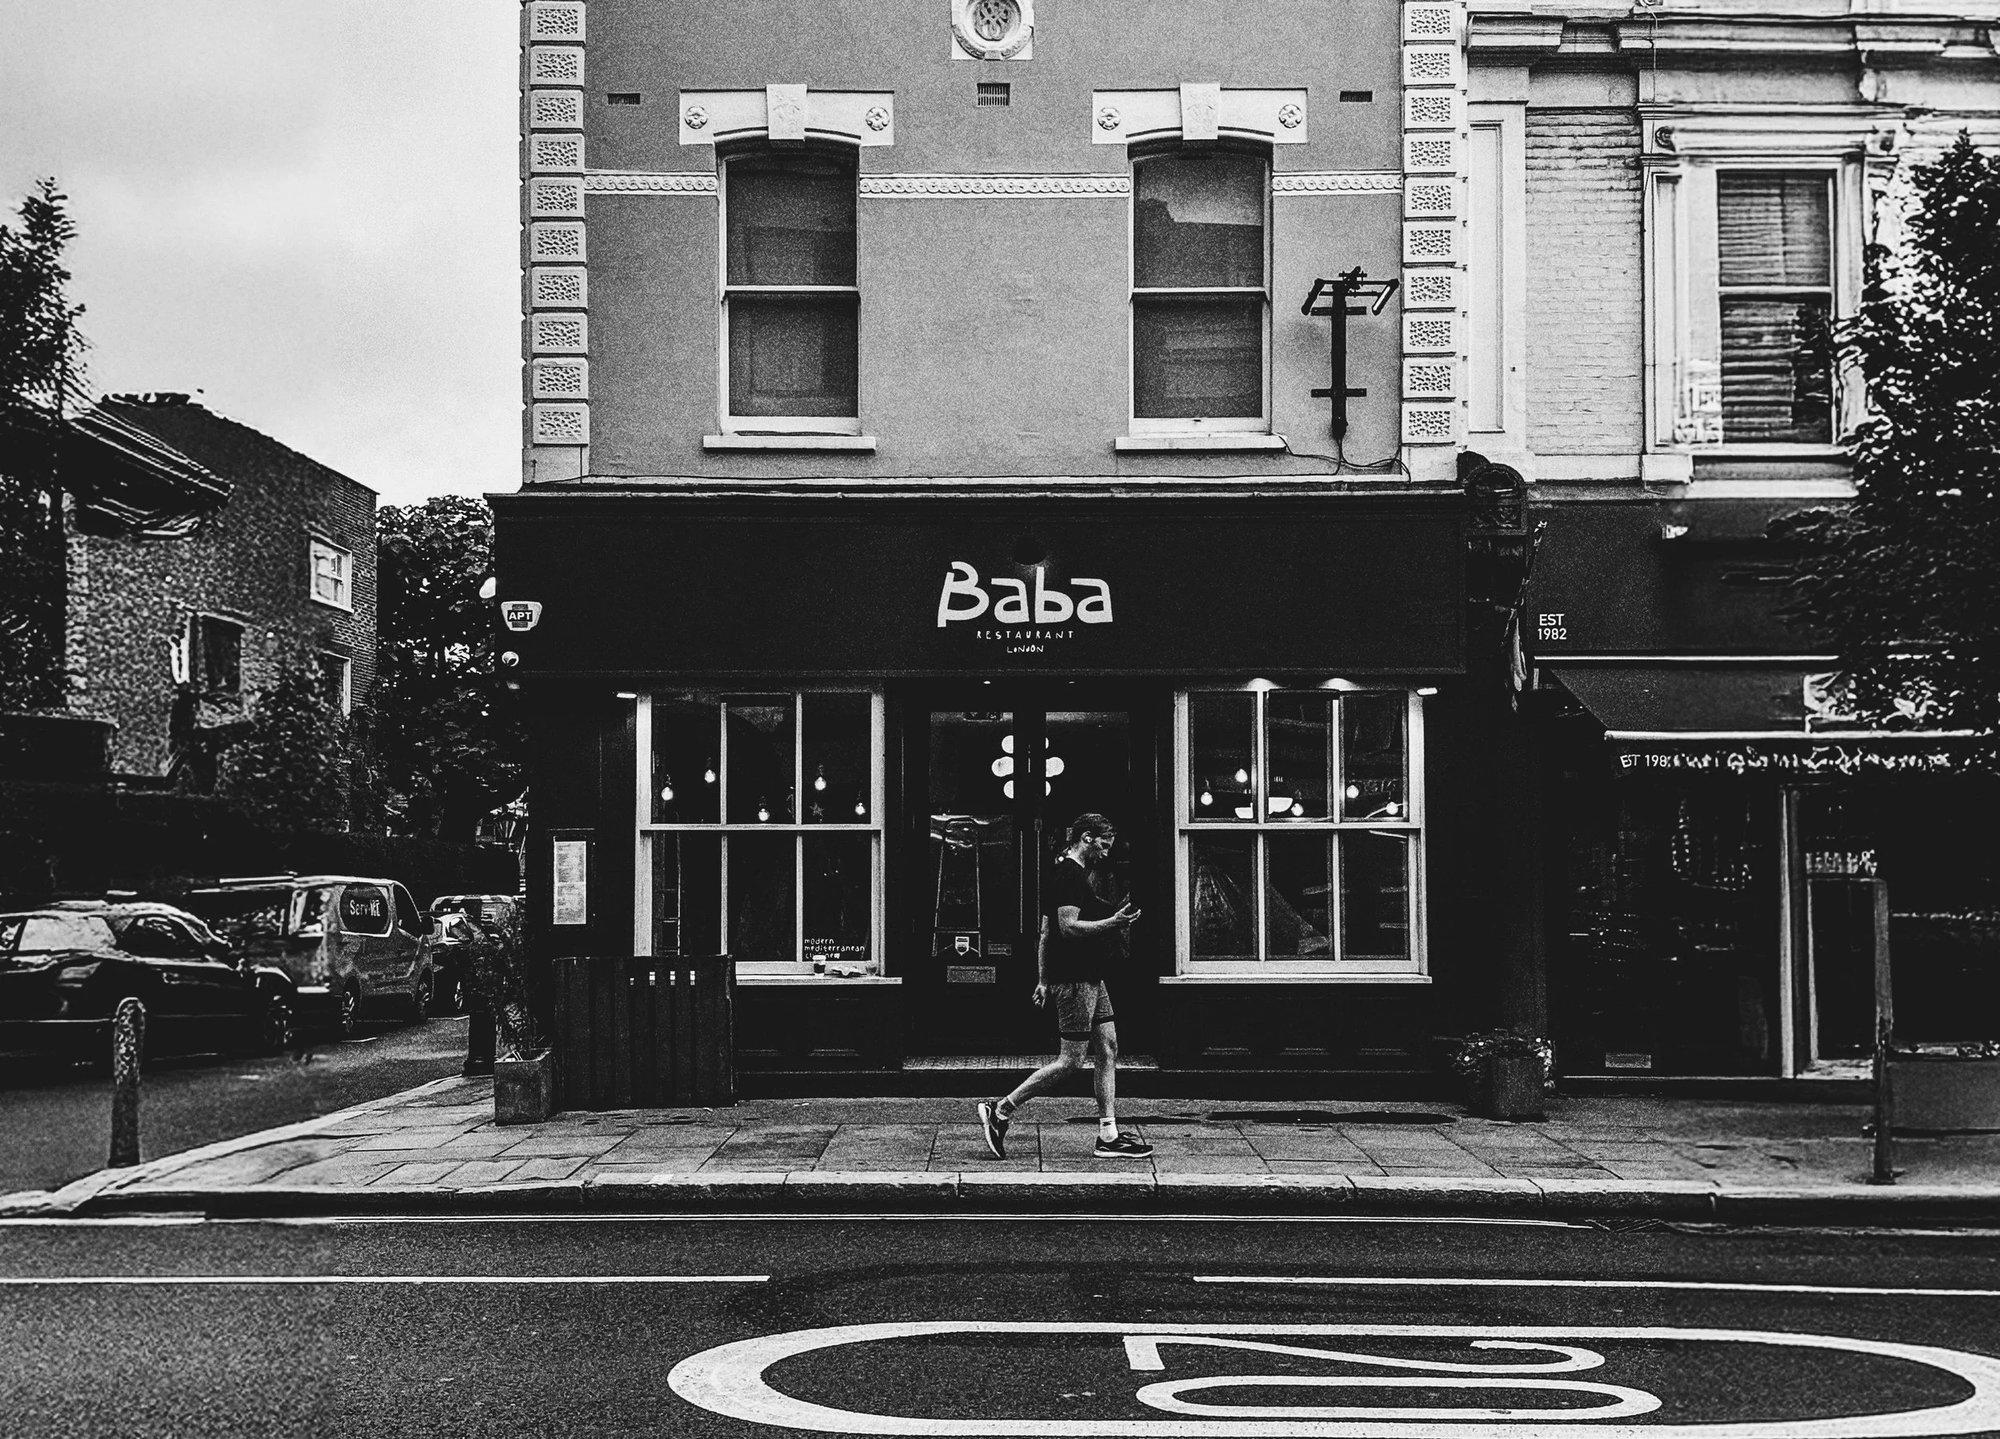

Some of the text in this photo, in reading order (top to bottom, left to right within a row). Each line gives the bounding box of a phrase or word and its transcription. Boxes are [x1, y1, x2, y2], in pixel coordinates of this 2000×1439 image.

[937, 560, 1114, 628] Baba
[508, 611, 532, 620] APT
[1539, 613, 1565, 626] EST
[976, 630, 1074, 640] RESTAURANT
[1537, 627, 1567, 640] 1982
